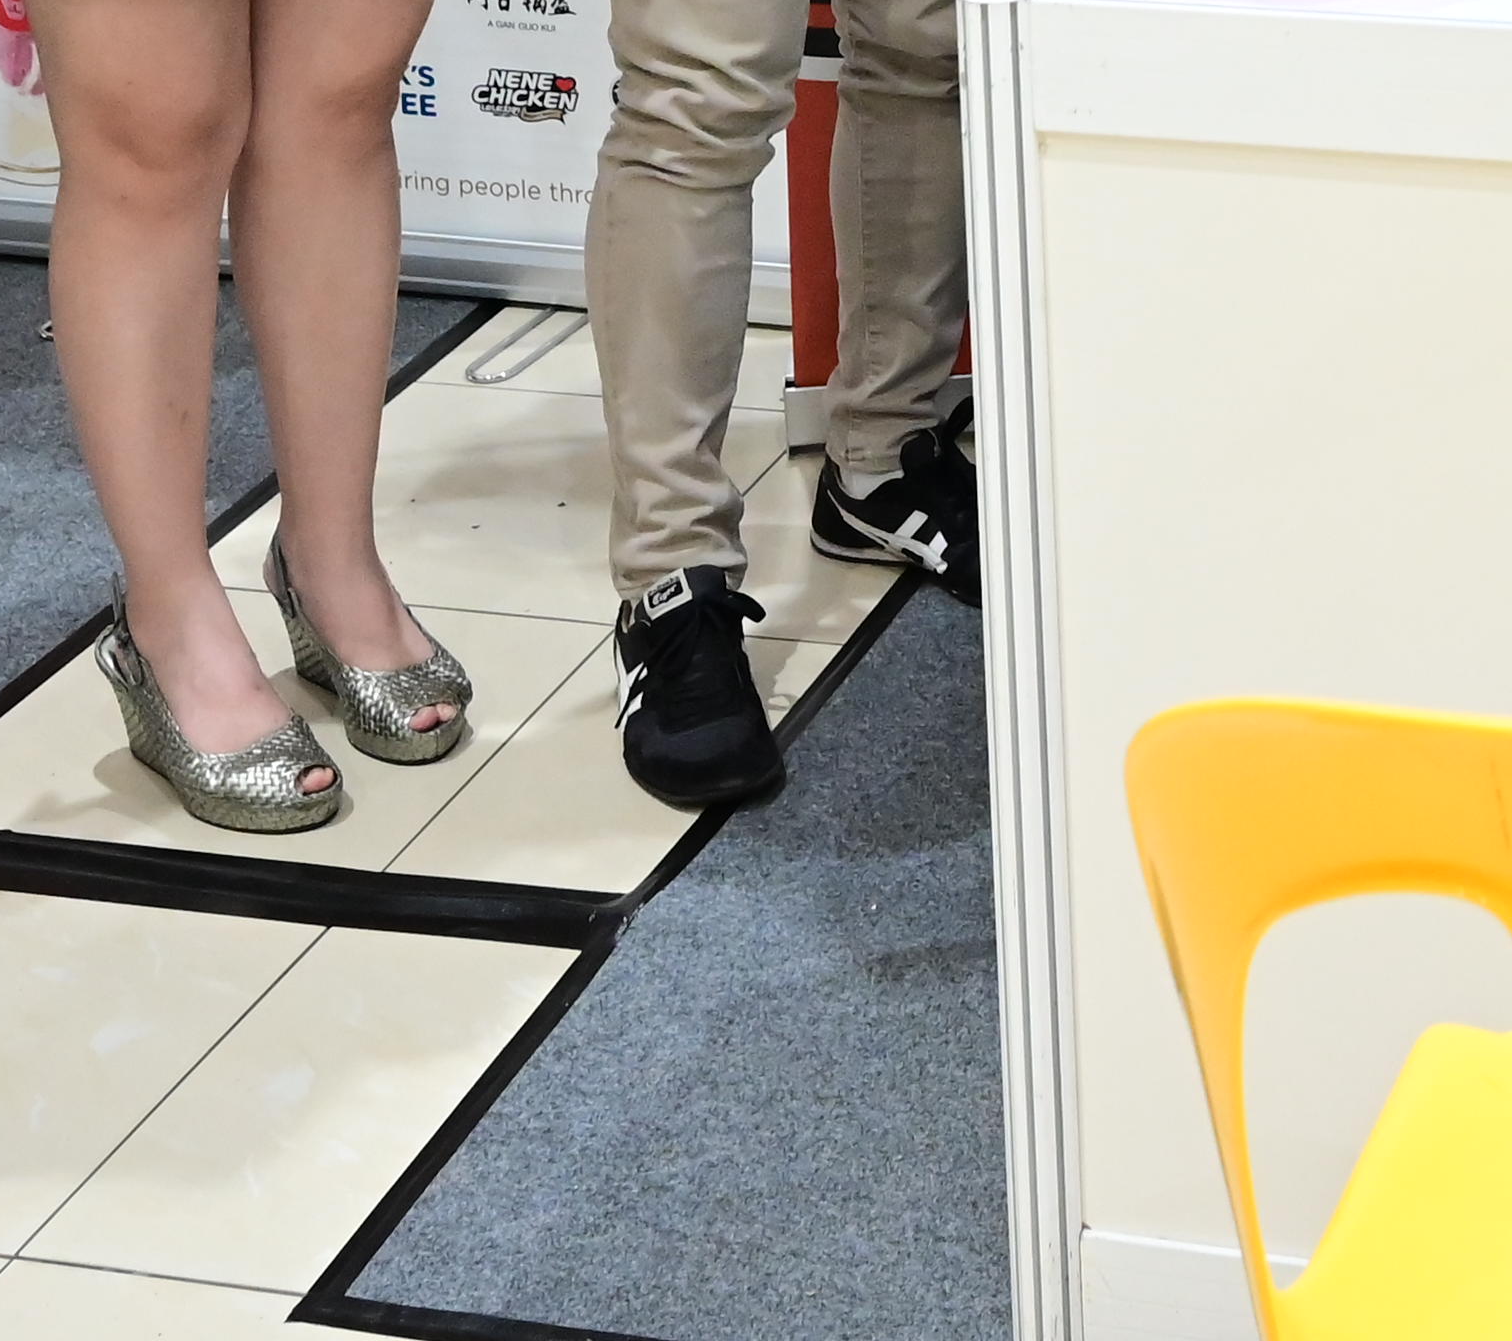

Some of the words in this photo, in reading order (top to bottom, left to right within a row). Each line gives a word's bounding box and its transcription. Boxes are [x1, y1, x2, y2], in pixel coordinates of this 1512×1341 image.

[496, 21, 516, 30] GAN
[518, 22, 539, 31] GUO
[541, 24, 556, 32] KUI
[488, 69, 554, 91] NENE
[473, 86, 578, 111] CHICKEN
[459, 179, 541, 203] people
